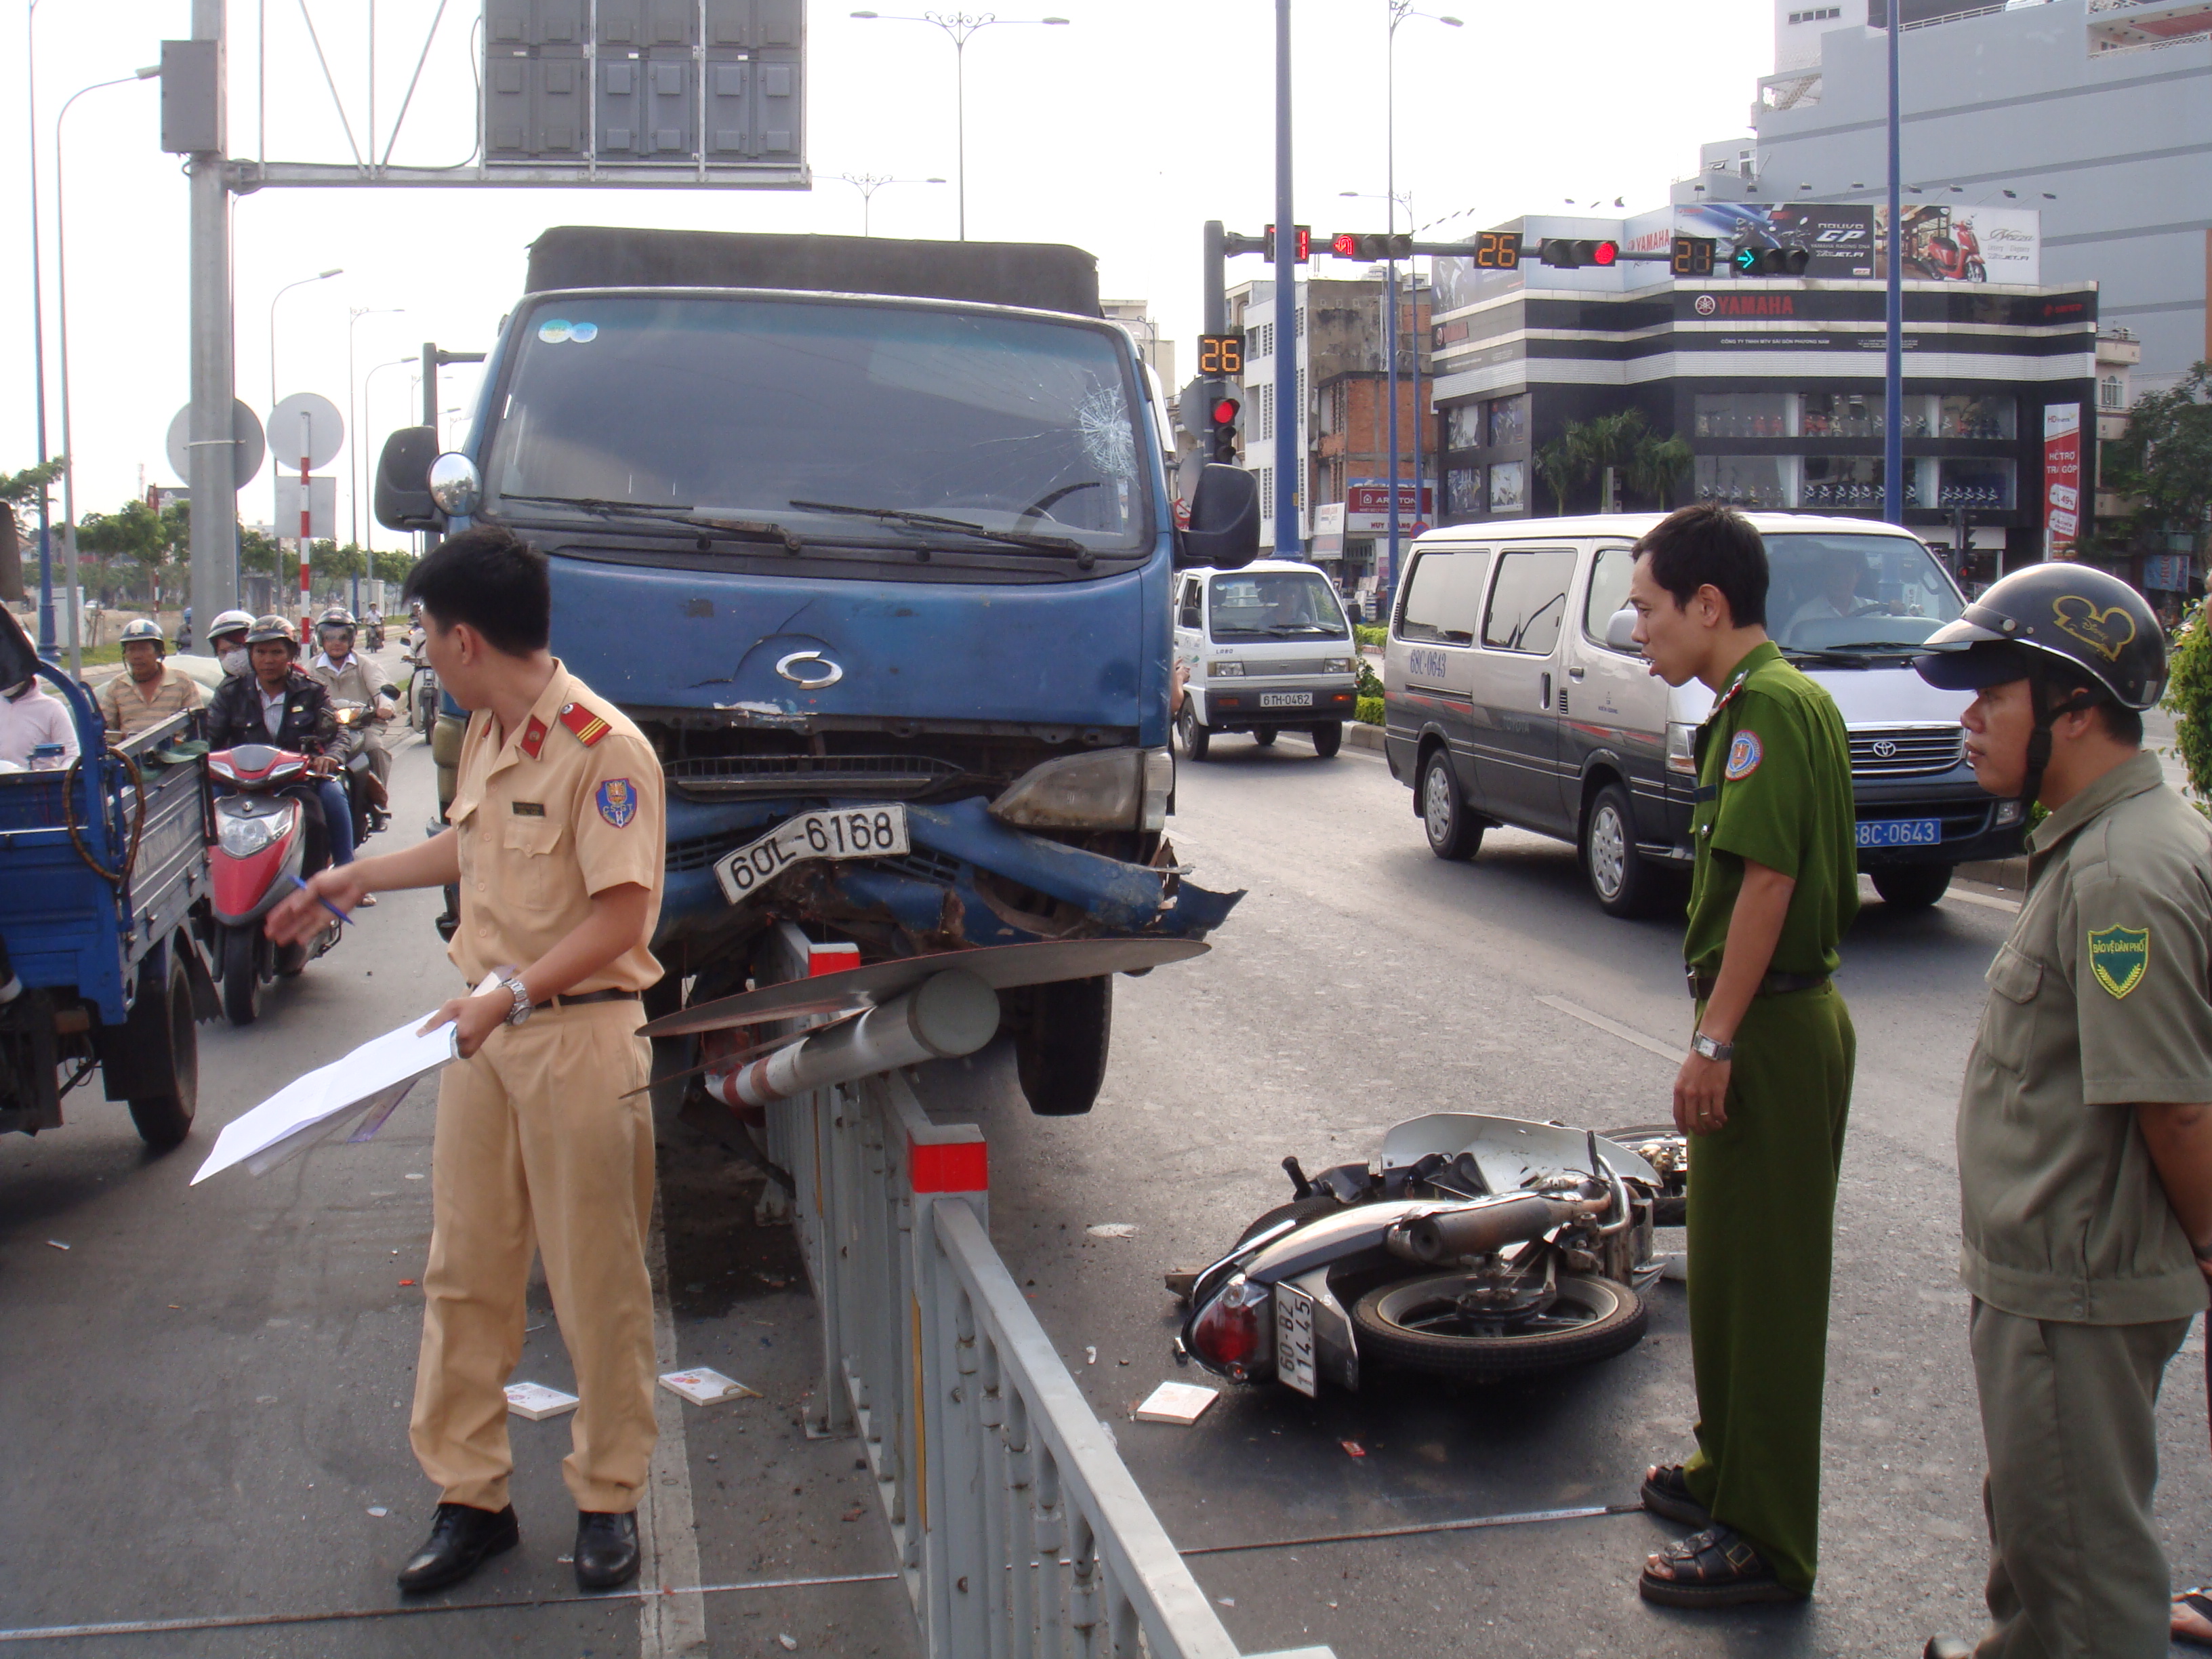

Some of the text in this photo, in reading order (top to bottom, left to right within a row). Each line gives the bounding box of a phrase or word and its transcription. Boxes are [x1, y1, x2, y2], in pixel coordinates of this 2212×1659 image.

[1477, 234, 1517, 267] 26
[1636, 228, 1671, 252] YAMAHA
[1816, 230, 1866, 242] GP
[1673, 241, 1710, 272] 21
[1717, 295, 1794, 314] YAMAHA
[1201, 339, 1241, 372] 26
[730, 812, 894, 890] 60L-6168
